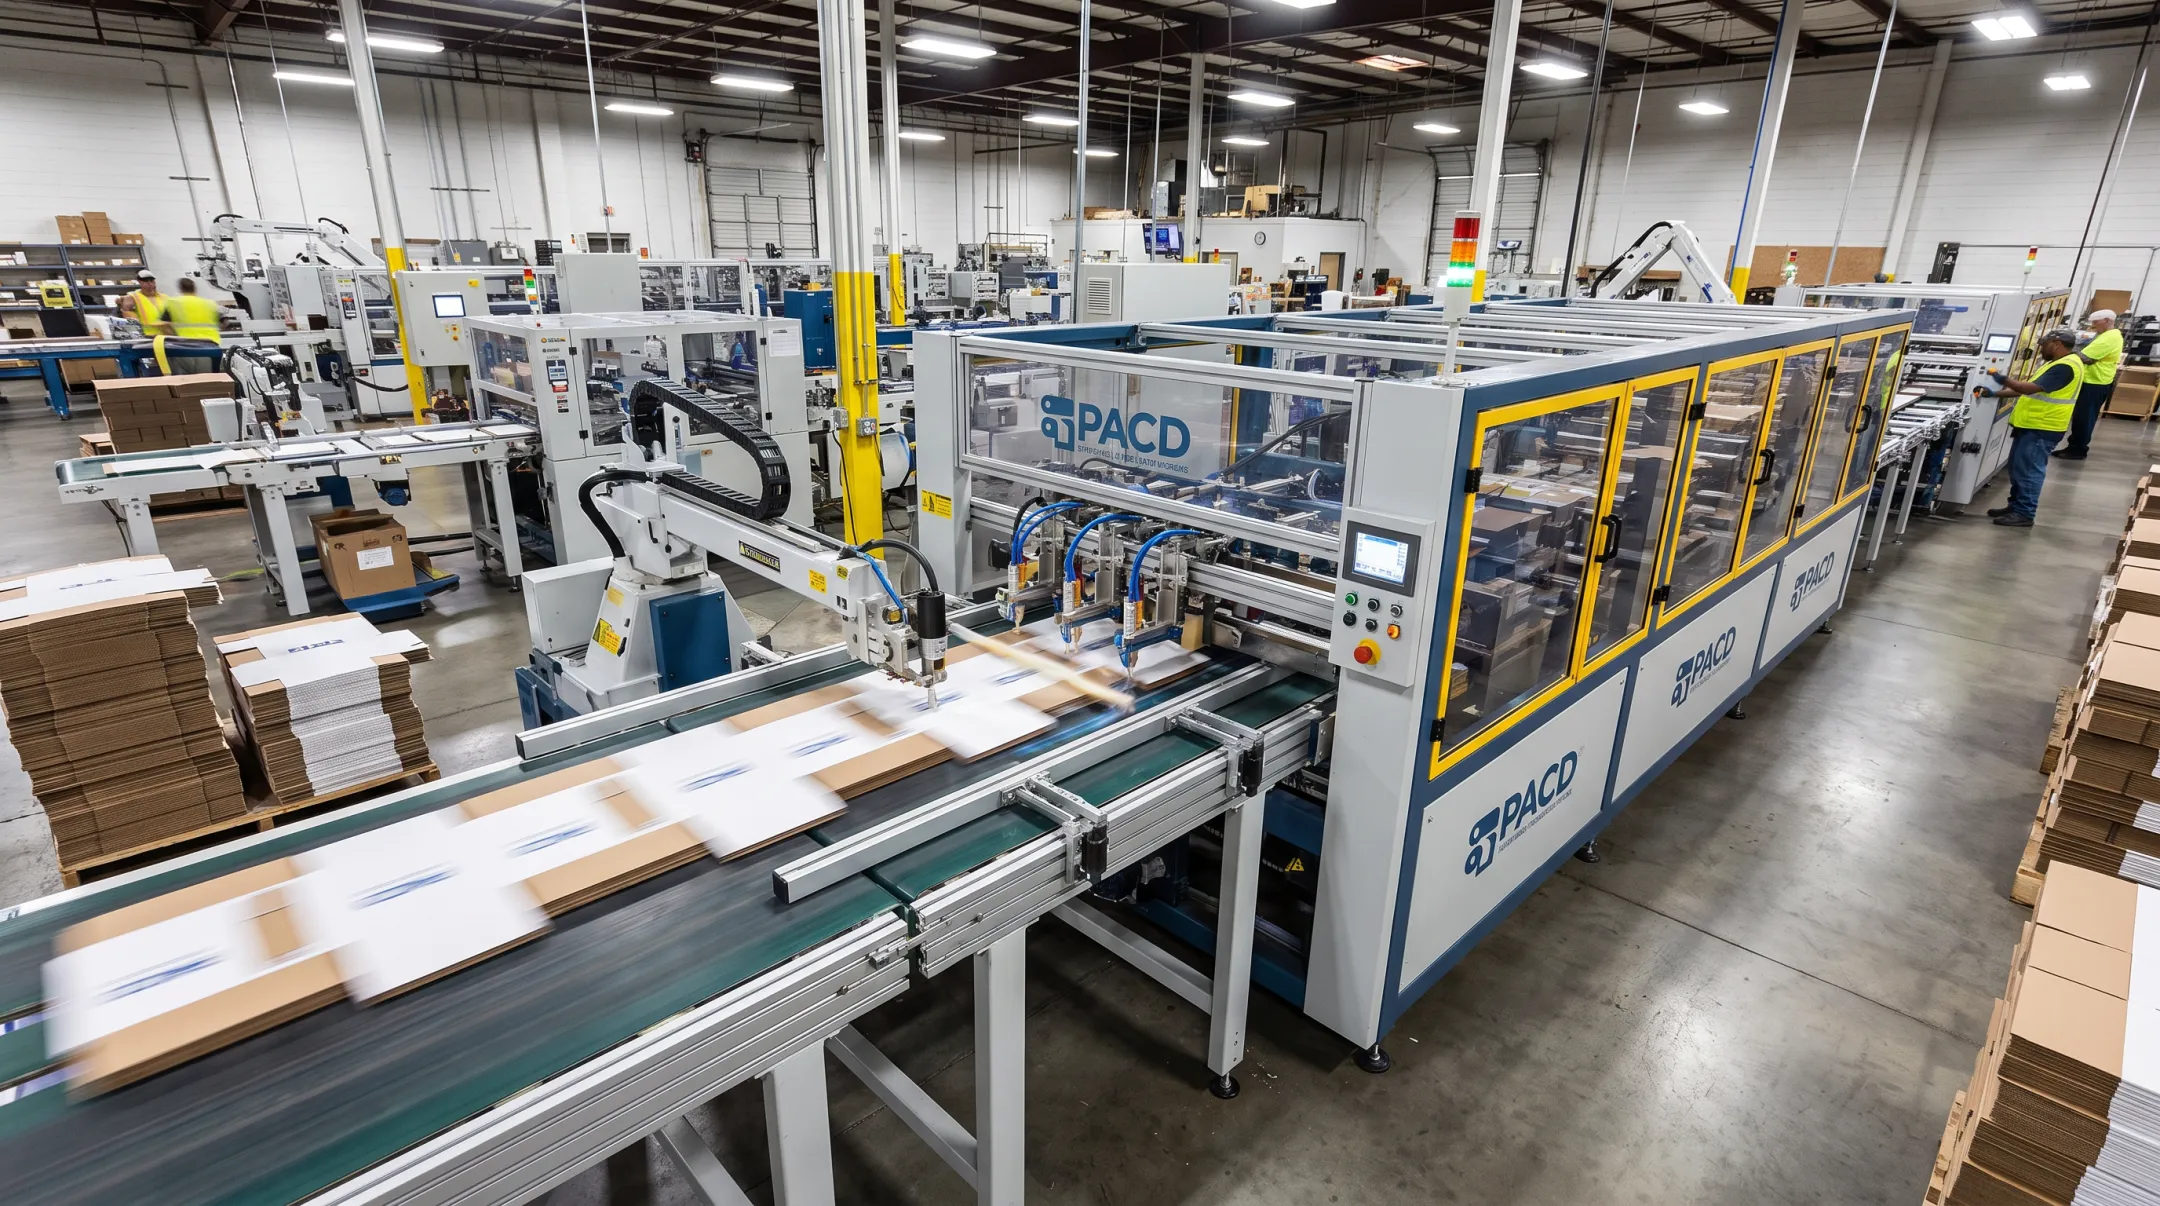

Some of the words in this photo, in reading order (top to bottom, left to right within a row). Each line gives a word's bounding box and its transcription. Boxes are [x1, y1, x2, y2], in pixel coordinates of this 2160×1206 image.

[1078, 402, 1191, 458] PACD
[1803, 551, 1835, 595] PACD
[1690, 626, 1737, 686] PACD
[1499, 750, 1578, 842] PACD
